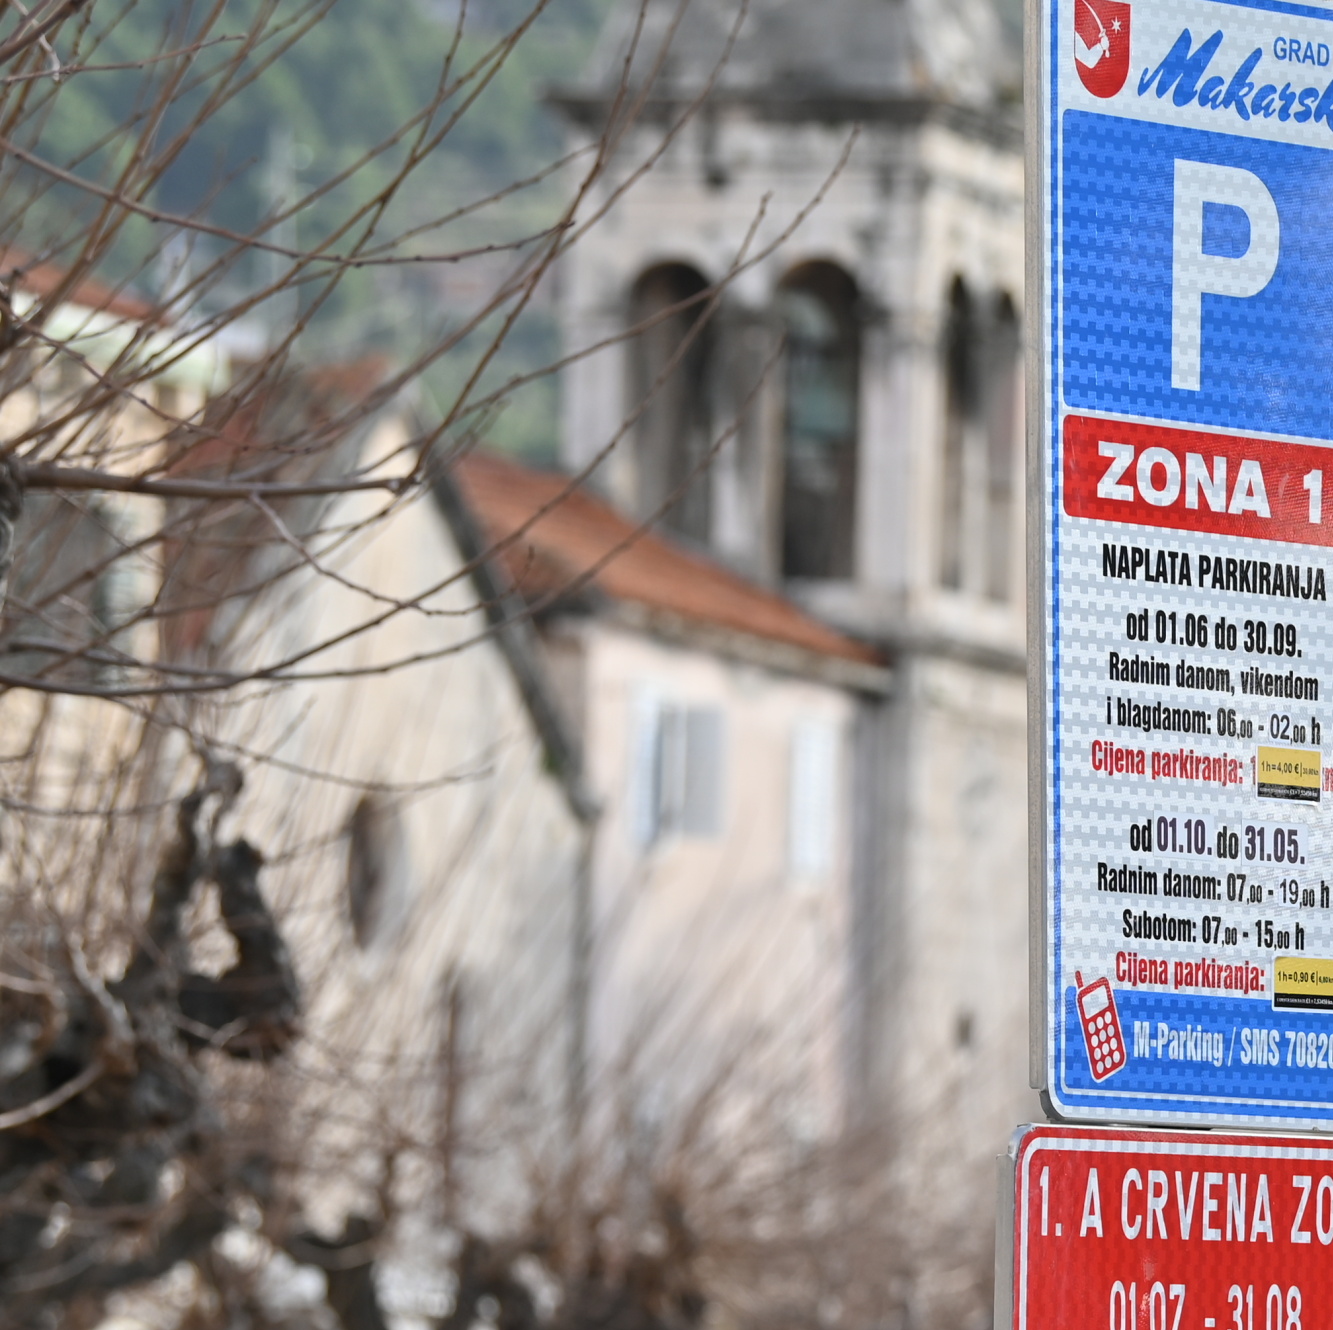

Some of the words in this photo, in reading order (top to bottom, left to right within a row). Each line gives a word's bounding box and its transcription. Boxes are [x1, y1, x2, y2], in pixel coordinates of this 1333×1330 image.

[1273, 37, 1330, 66] GRAD
[1170, 158, 1280, 391] P
[1096, 440, 1271, 519] ZONA
[1303, 469, 1323, 523] 1
[1102, 543, 1192, 586] NAPLATA
[1199, 554, 1326, 601] PARKIRANJA
[1126, 608, 1149, 641] od
[1155, 610, 1208, 647] 01.06
[1215, 616, 1237, 650] do
[1243, 620, 1302, 657] 30.09.
[1109, 652, 1170, 687] Radnim
[1175, 659, 1235, 696] danom,
[1241, 667, 1319, 700] vikendom
[1106, 696, 1112, 724] i
[1117, 698, 1211, 736] blagdanom:
[1217, 707, 1253, 738] 06,00
[1311, 716, 1320, 745] h
[1091, 739, 1145, 775] Cijena
[1151, 744, 1243, 786] parkiranja:
[1130, 819, 1152, 852] od
[1156, 816, 1212, 855] 01.10.
[1216, 826, 1239, 859] do
[1245, 826, 1305, 865] 31.05.
[1098, 862, 1157, 896] Radnim
[1163, 868, 1221, 900] danom:
[1227, 874, 1262, 905] 07,00
[1320, 880, 1330, 908] h
[1122, 909, 1197, 943] Subotom:
[1202, 915, 1237, 947] 07,00
[1255, 920, 1290, 951] 15,00
[1295, 922, 1305, 950] h
[1115, 950, 1168, 988] Cijena
[1174, 957, 1265, 996] parkiranja:
[1133, 1020, 1223, 1067] M-Parking
[1240, 1027, 1280, 1065] SMS
[1039, 1165, 1062, 1237] 1.
[1079, 1167, 1104, 1238] A
[1120, 1167, 1274, 1243] CRVENA
